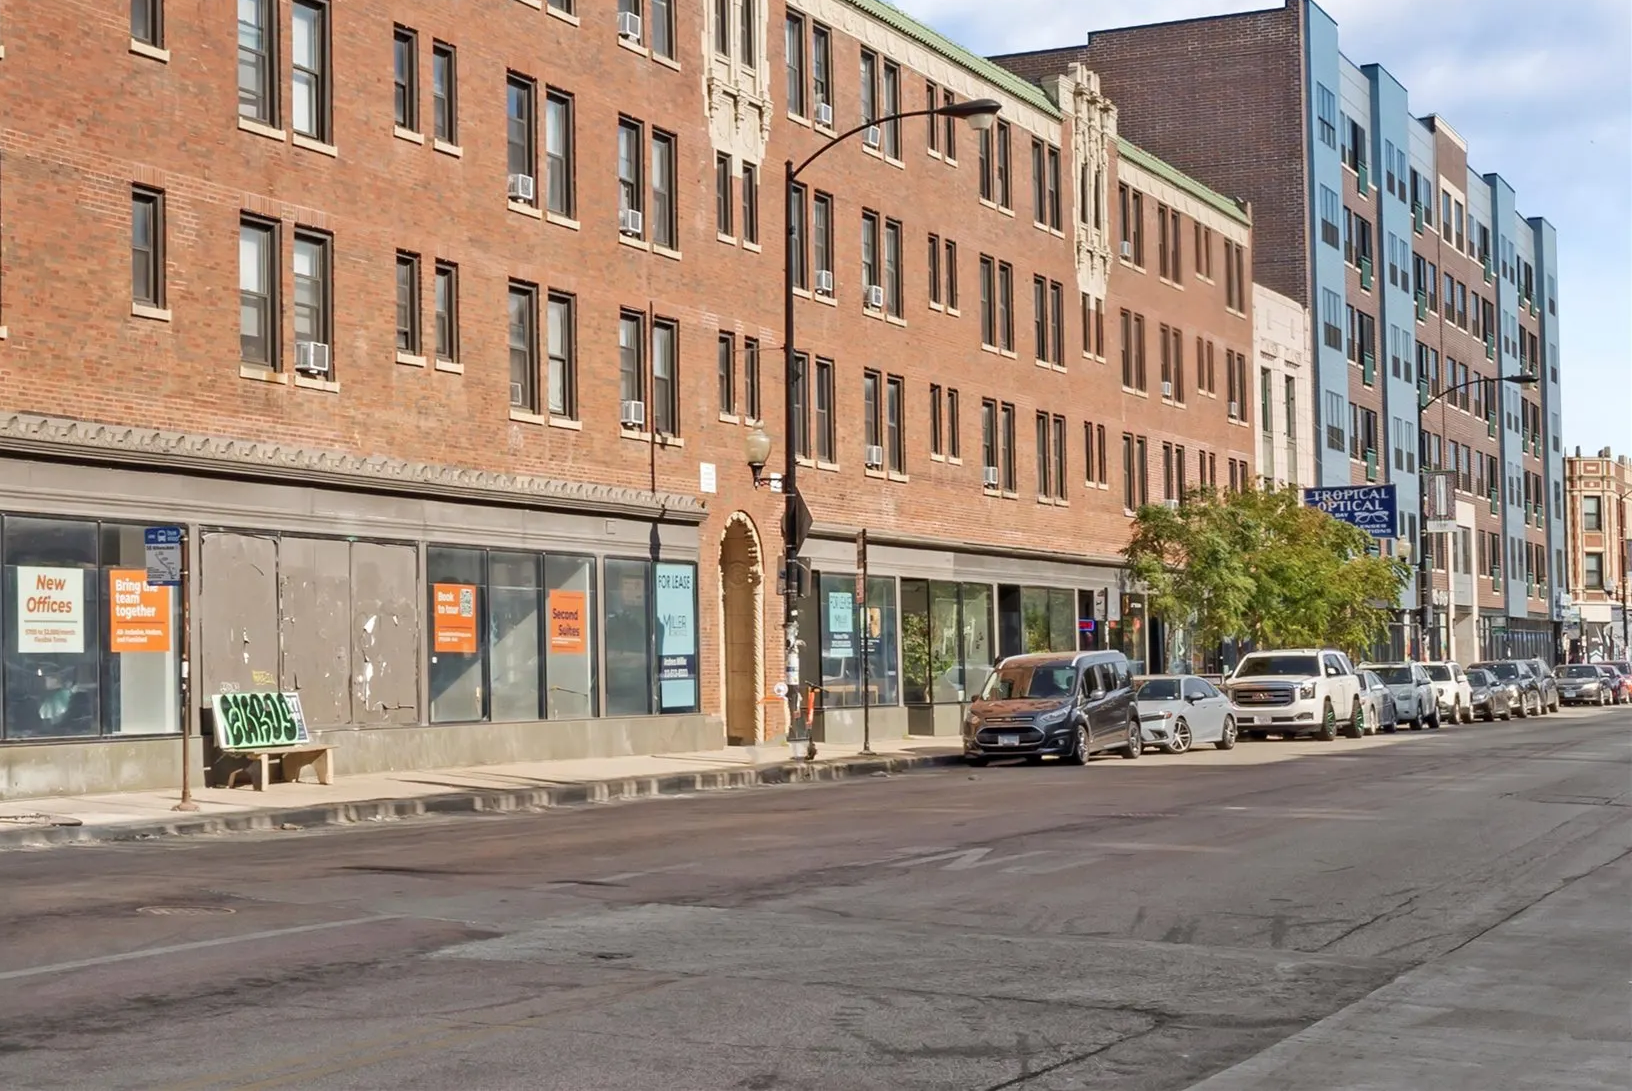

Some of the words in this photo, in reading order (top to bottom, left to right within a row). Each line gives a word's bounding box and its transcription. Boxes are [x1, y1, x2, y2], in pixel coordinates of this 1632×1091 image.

[1312, 488, 1390, 501] TROPICAL
[1317, 500, 1384, 512] OPTICAL
[35, 574, 66, 591] New
[115, 578, 141, 594] Bring
[658, 575, 671, 589] FOR
[672, 575, 690, 590] LEASE
[26, 595, 73, 614] Offices
[115, 593, 140, 604] team
[115, 605, 156, 619] together
[552, 607, 578, 620] Second
[558, 624, 580, 636] Suites
